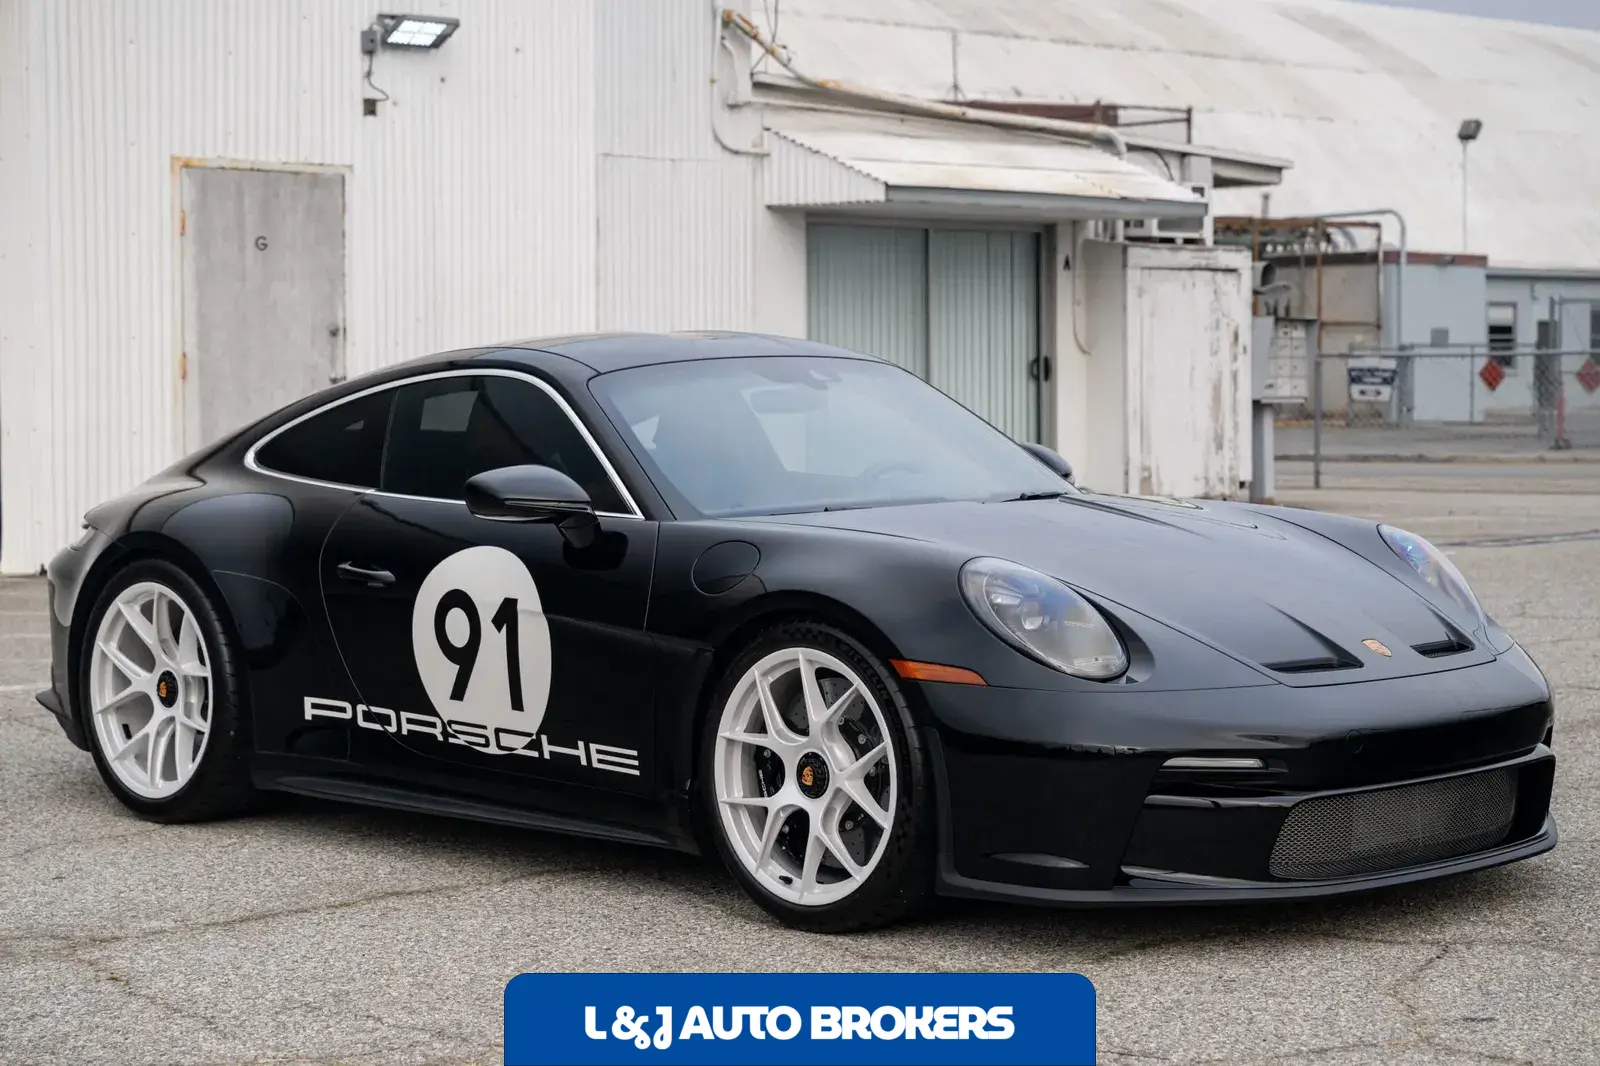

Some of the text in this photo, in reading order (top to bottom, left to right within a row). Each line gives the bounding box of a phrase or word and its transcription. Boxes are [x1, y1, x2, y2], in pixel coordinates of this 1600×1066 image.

[255, 236, 268, 251] G
[434, 588, 524, 712] 91
[304, 696, 640, 776] PORSCHE
